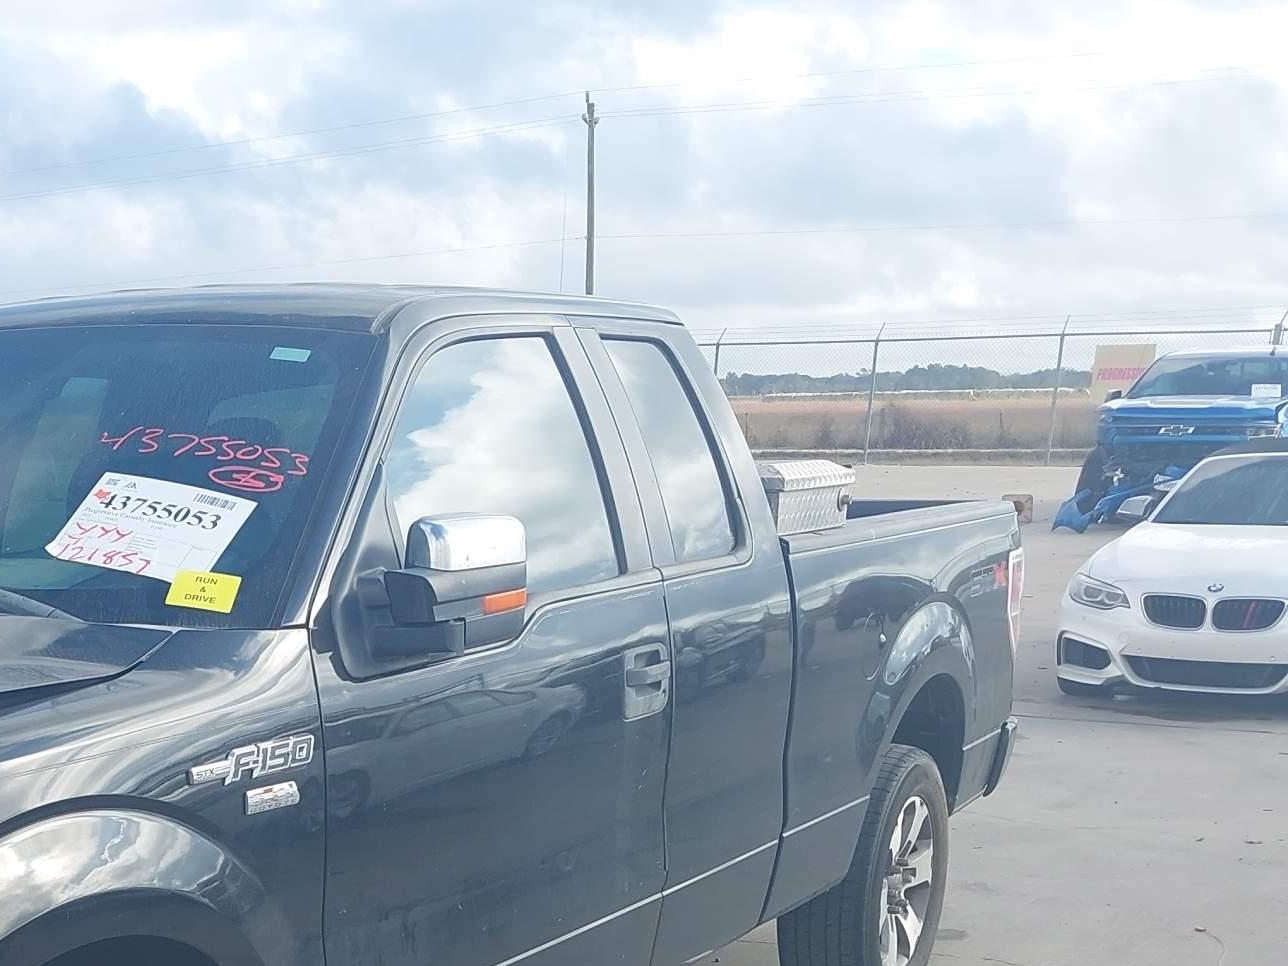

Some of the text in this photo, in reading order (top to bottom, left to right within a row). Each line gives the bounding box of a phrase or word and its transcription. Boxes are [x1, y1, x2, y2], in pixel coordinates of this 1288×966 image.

[97, 426, 310, 476] 43755053
[99, 493, 223, 531] 43755053
[194, 575, 219, 586] RUN
[183, 593, 217, 604] DRIVE
